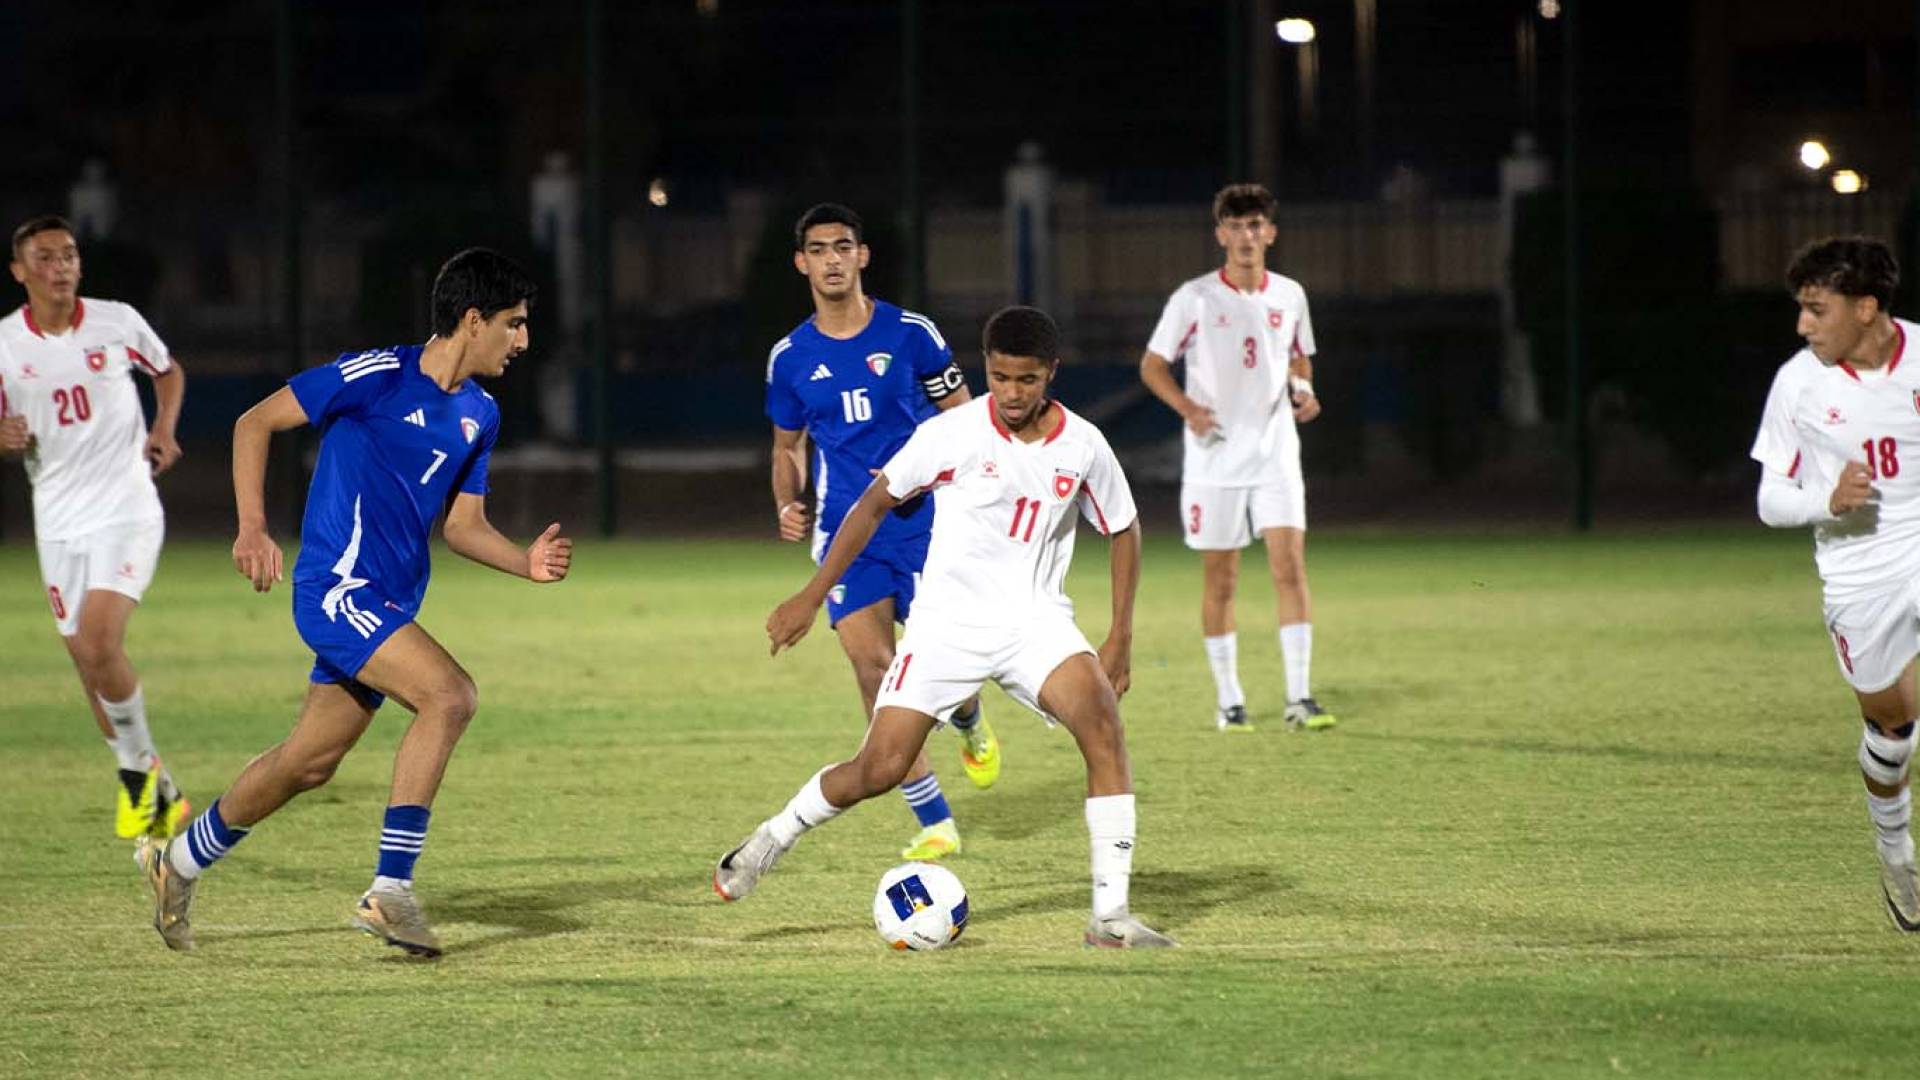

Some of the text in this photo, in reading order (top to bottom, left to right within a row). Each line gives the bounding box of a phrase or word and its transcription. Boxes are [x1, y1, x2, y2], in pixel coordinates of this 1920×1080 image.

[1243, 336, 1257, 369] 3
[53, 384, 91, 426] 20
[841, 388, 872, 423] 16
[420, 449, 447, 484] 7
[1862, 436, 1899, 480] 18
[1009, 496, 1041, 542] 11
[1190, 504, 1201, 534] 3
[49, 585, 65, 619] 0
